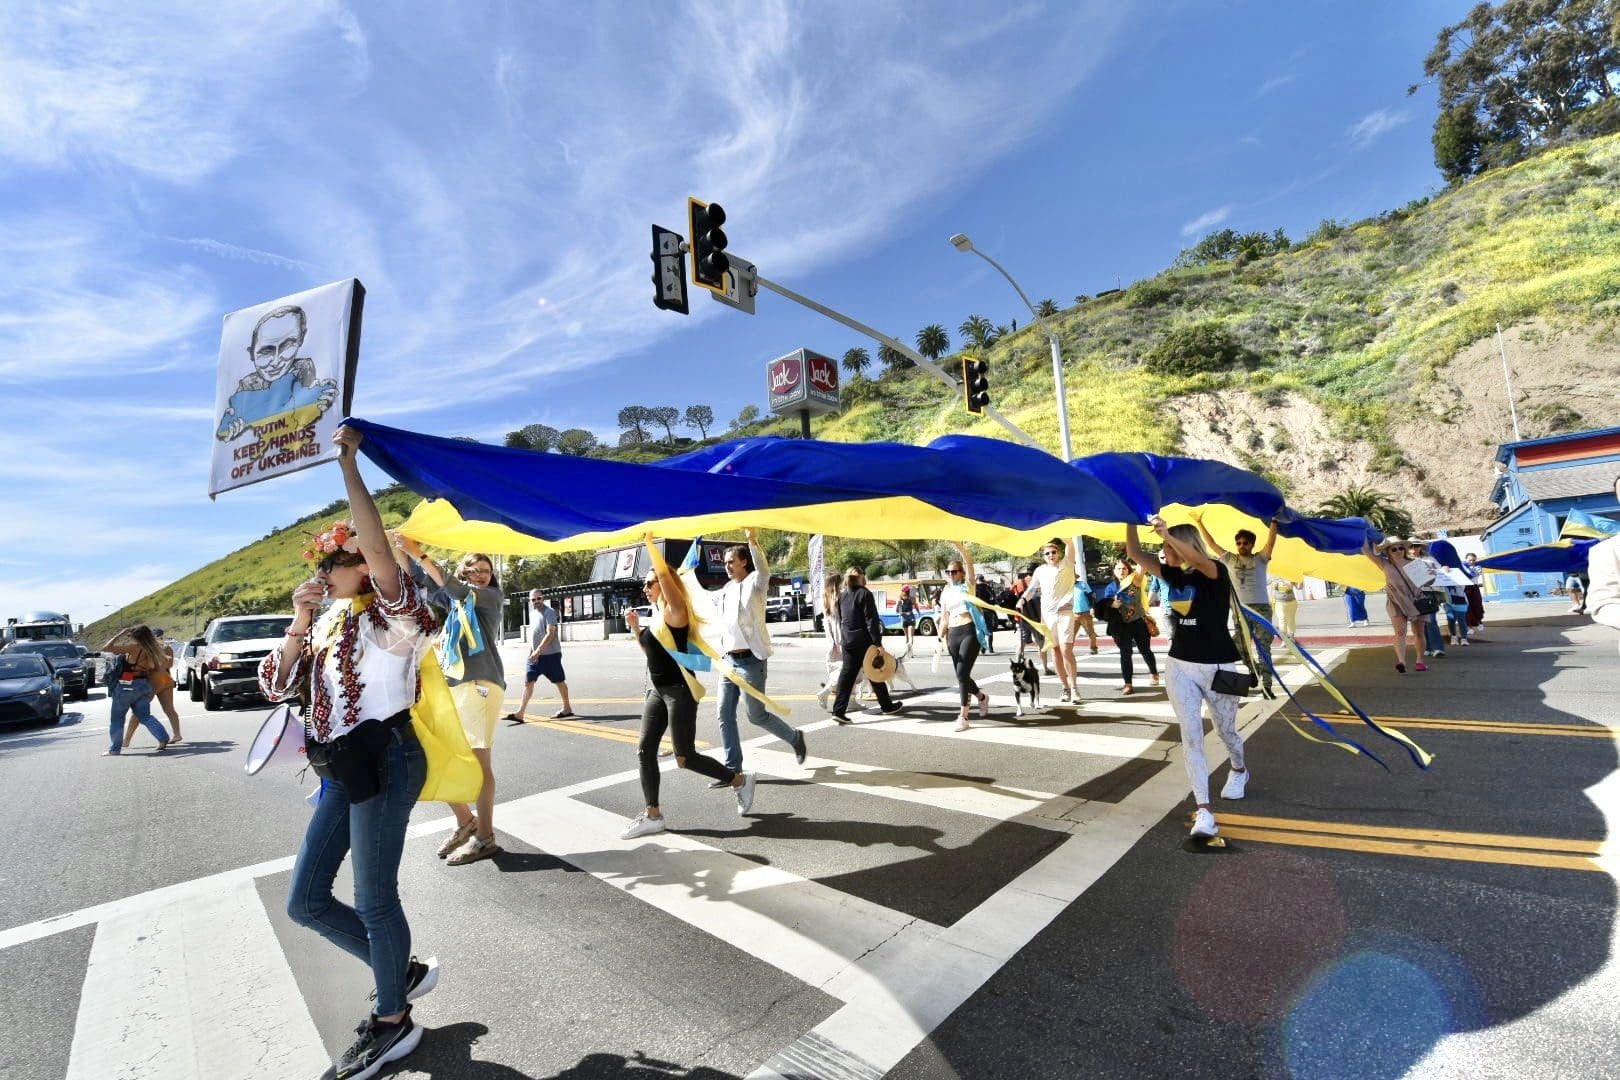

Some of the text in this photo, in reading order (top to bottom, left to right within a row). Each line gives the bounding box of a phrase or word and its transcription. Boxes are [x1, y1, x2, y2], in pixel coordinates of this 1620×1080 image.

[771, 362, 799, 391] Jack
[810, 360, 837, 388] Jack
[233, 425, 316, 461] KEEP HANDS
[231, 461, 254, 479] OFF
